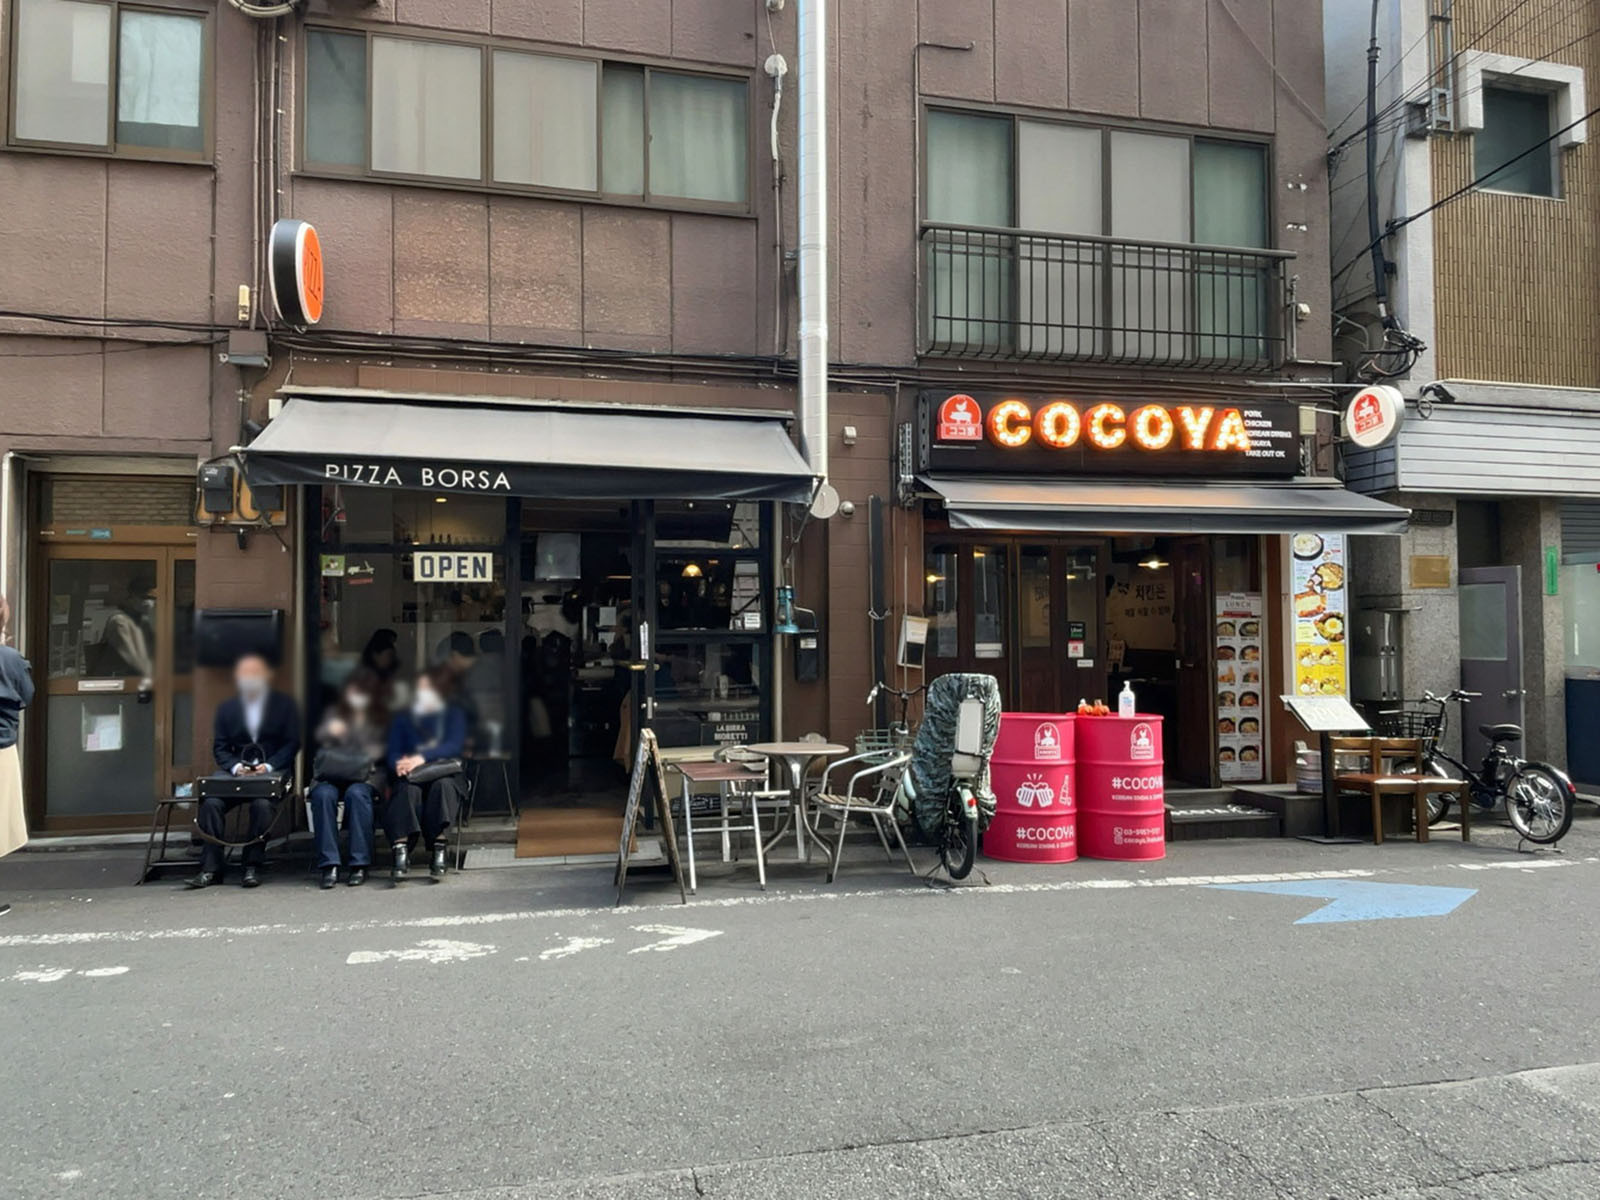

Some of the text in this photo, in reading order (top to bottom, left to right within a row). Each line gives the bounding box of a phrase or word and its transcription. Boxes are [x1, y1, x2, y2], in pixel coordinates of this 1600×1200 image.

[1244, 410, 1262, 418] PORK
[988, 400, 1250, 452] COCOYA
[1244, 420, 1272, 428] CHICKEN
[1275, 450, 1286, 458] OK
[325, 464, 511, 490] PIZZA BORSA
[420, 555, 487, 578] OPEN
[1016, 825, 1074, 841] #COCOYA
